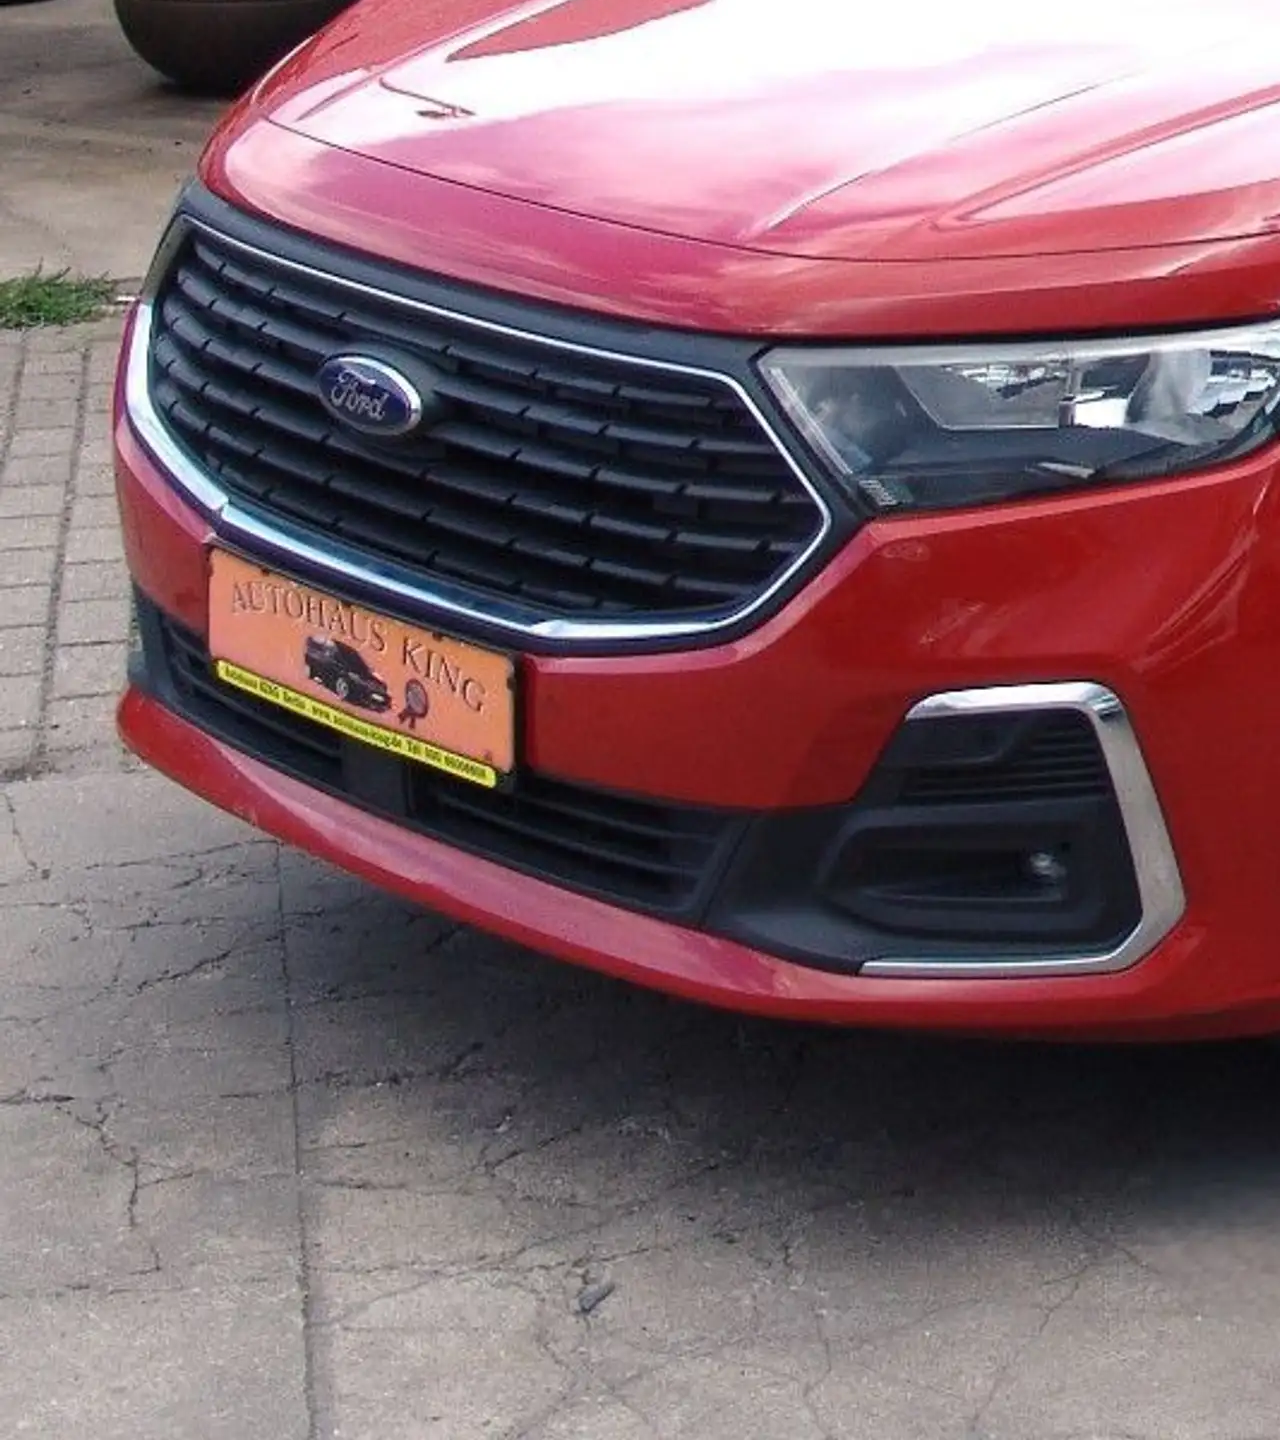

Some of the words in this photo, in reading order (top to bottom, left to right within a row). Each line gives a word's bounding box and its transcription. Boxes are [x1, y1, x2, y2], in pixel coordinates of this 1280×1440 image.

[330, 369, 386, 421] Ford
[231, 581, 388, 654] AUTOHAUS
[402, 635, 486, 712] KING
